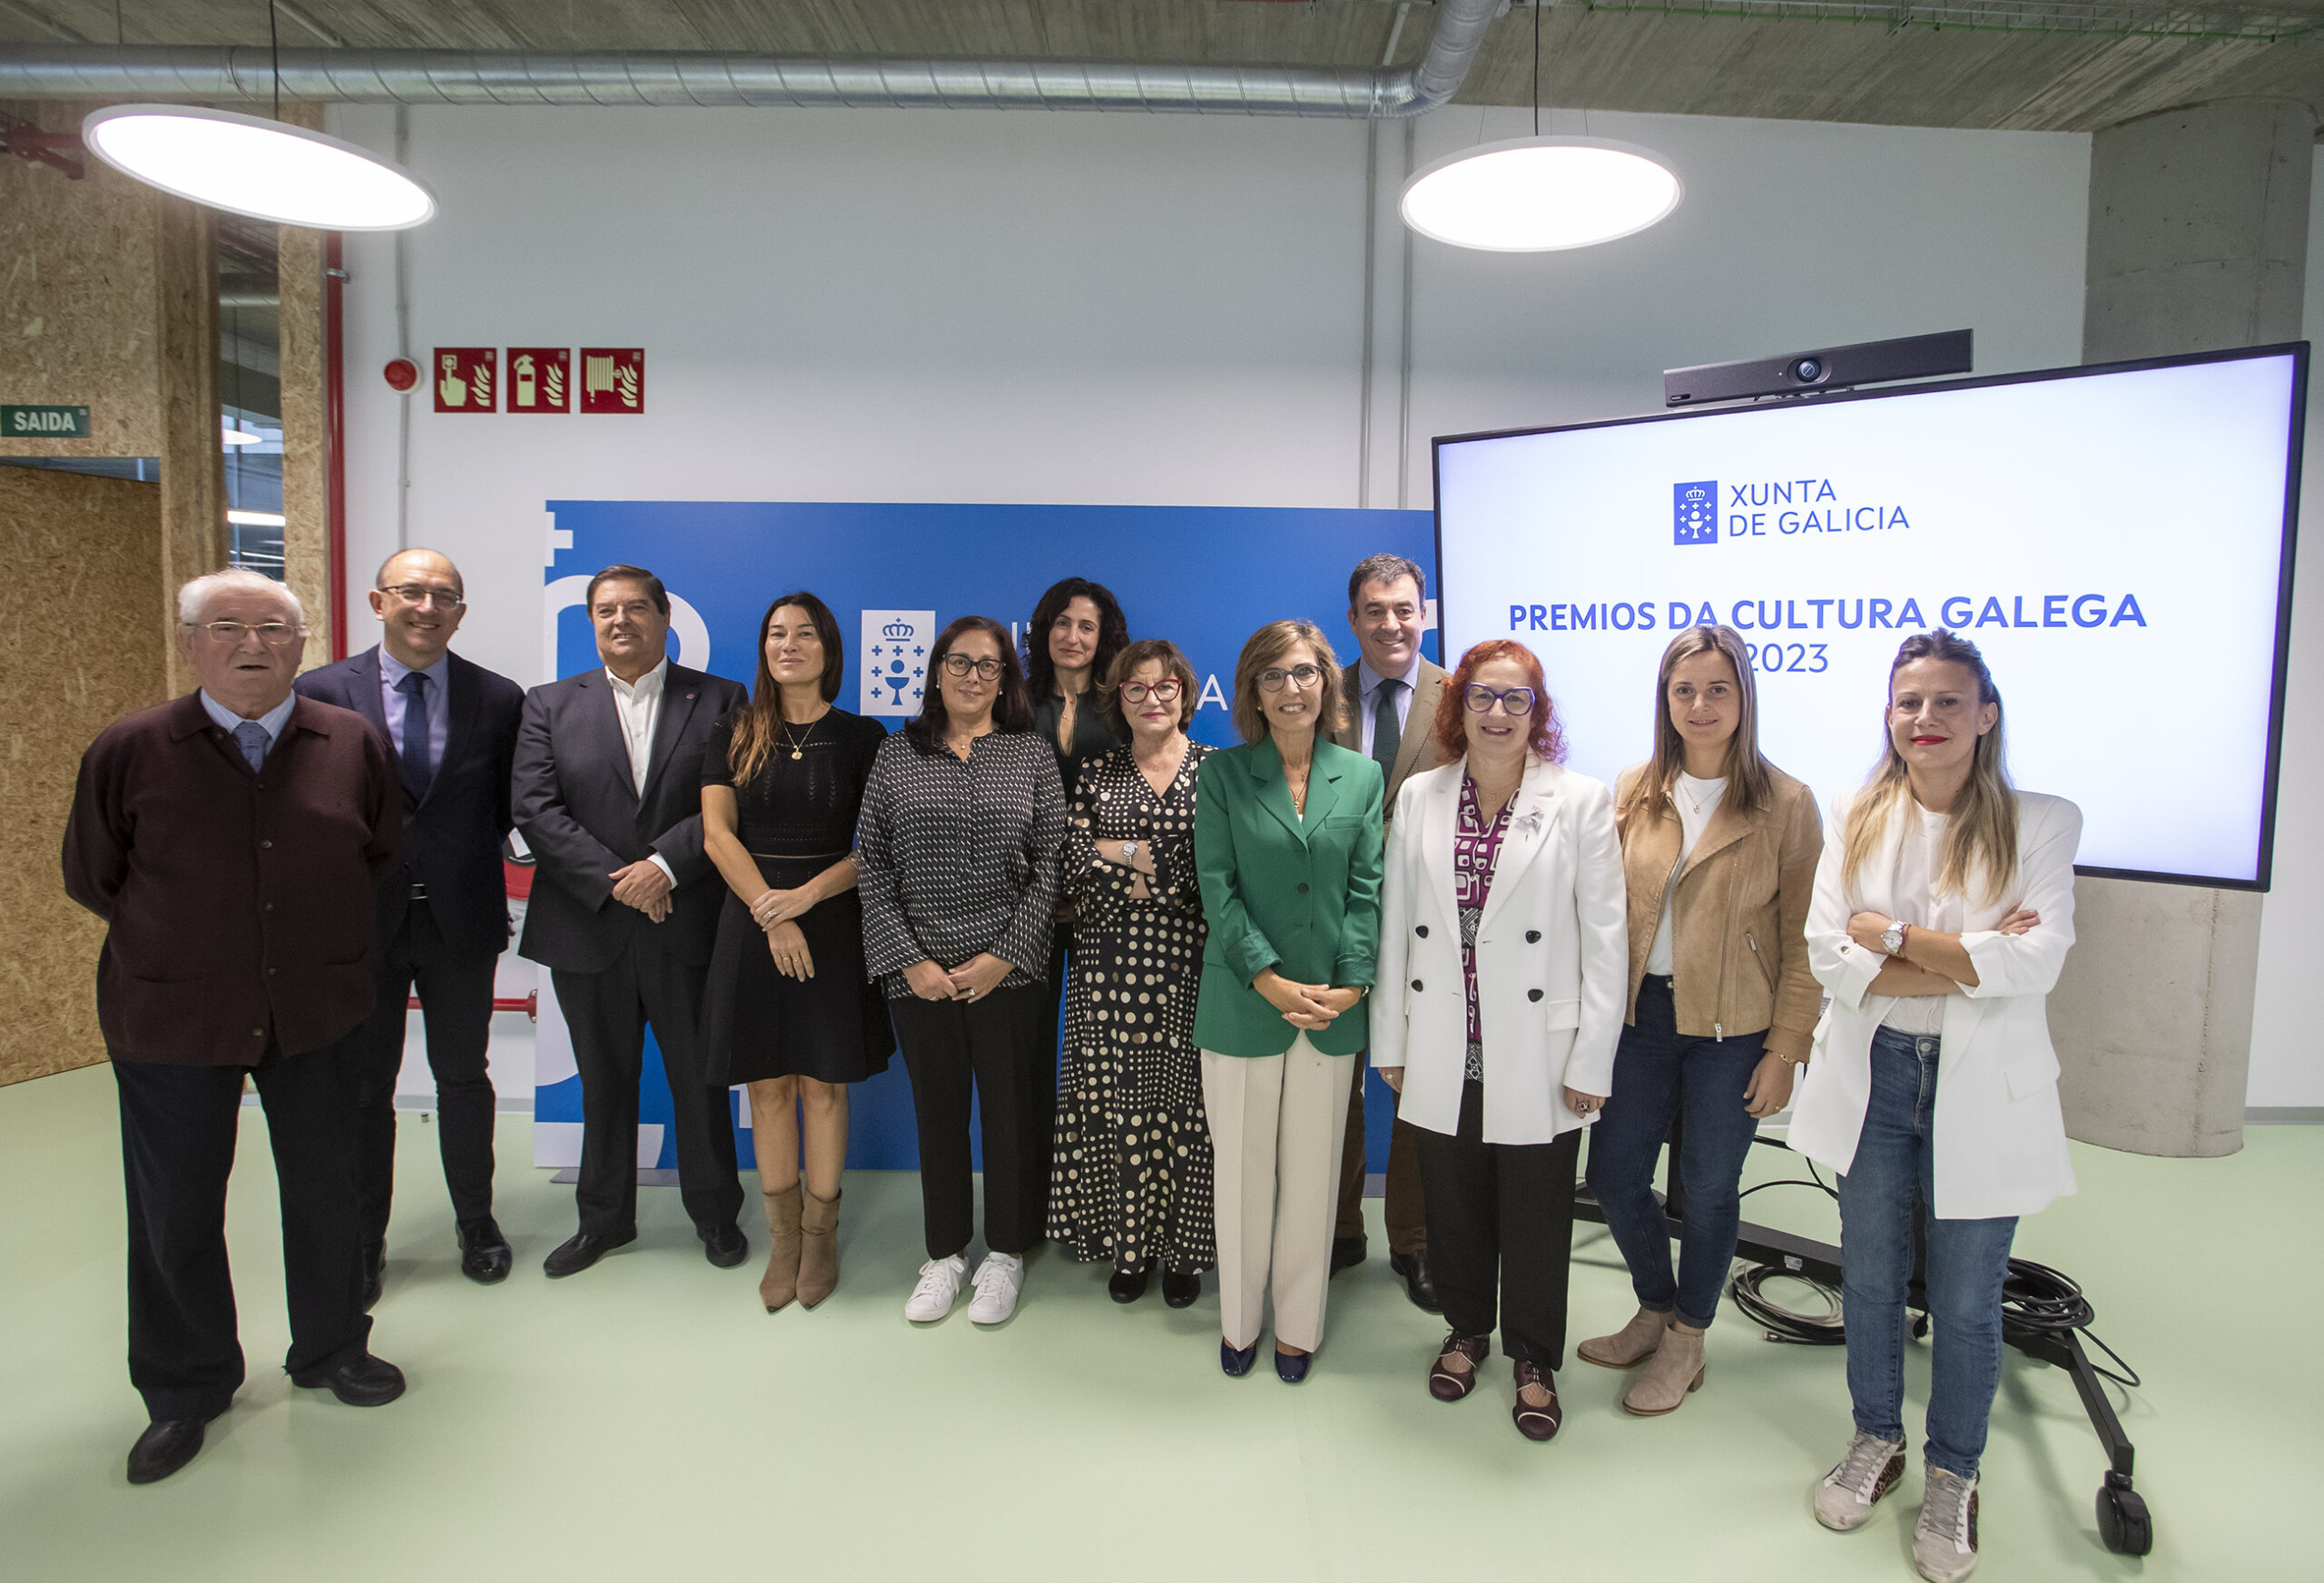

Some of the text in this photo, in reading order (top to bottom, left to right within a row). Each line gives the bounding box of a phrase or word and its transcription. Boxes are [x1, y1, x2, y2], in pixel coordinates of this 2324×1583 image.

[15, 411, 76, 432] SAIDA
[1730, 478, 1837, 507] XUNTA
[1729, 506, 1910, 536] DE GALICIA
[1510, 594, 2148, 631] PREMIOS DA CULTURA GALEGA
